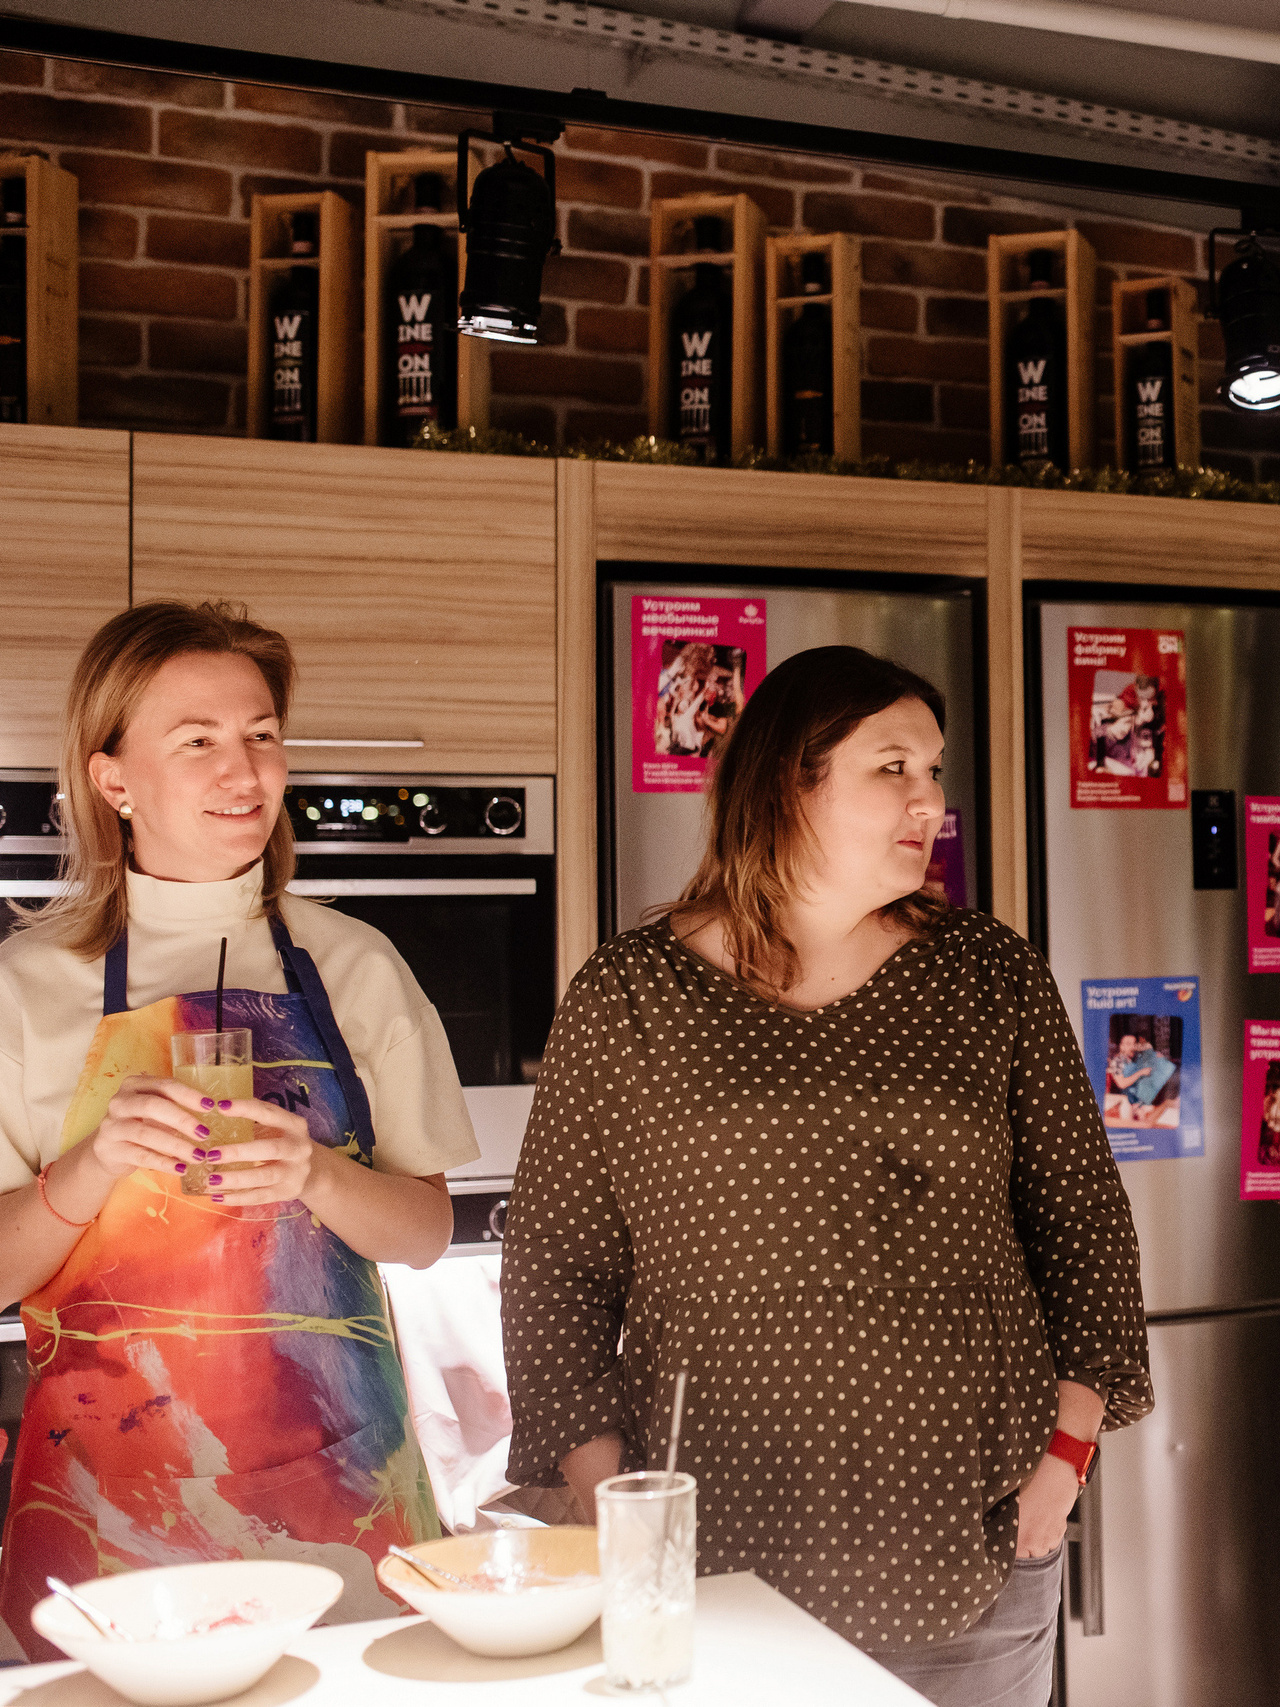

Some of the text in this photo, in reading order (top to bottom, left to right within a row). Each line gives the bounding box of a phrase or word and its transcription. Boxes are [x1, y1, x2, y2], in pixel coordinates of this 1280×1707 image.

[642, 598, 701, 612] Устроим
[641, 612, 720, 625] необычные
[641, 625, 719, 638] вечеринки!
[1074, 632, 1126, 645] Устроим
[1086, 986, 1139, 998] Устроим
[1086, 997, 1137, 1009] fluid art!
